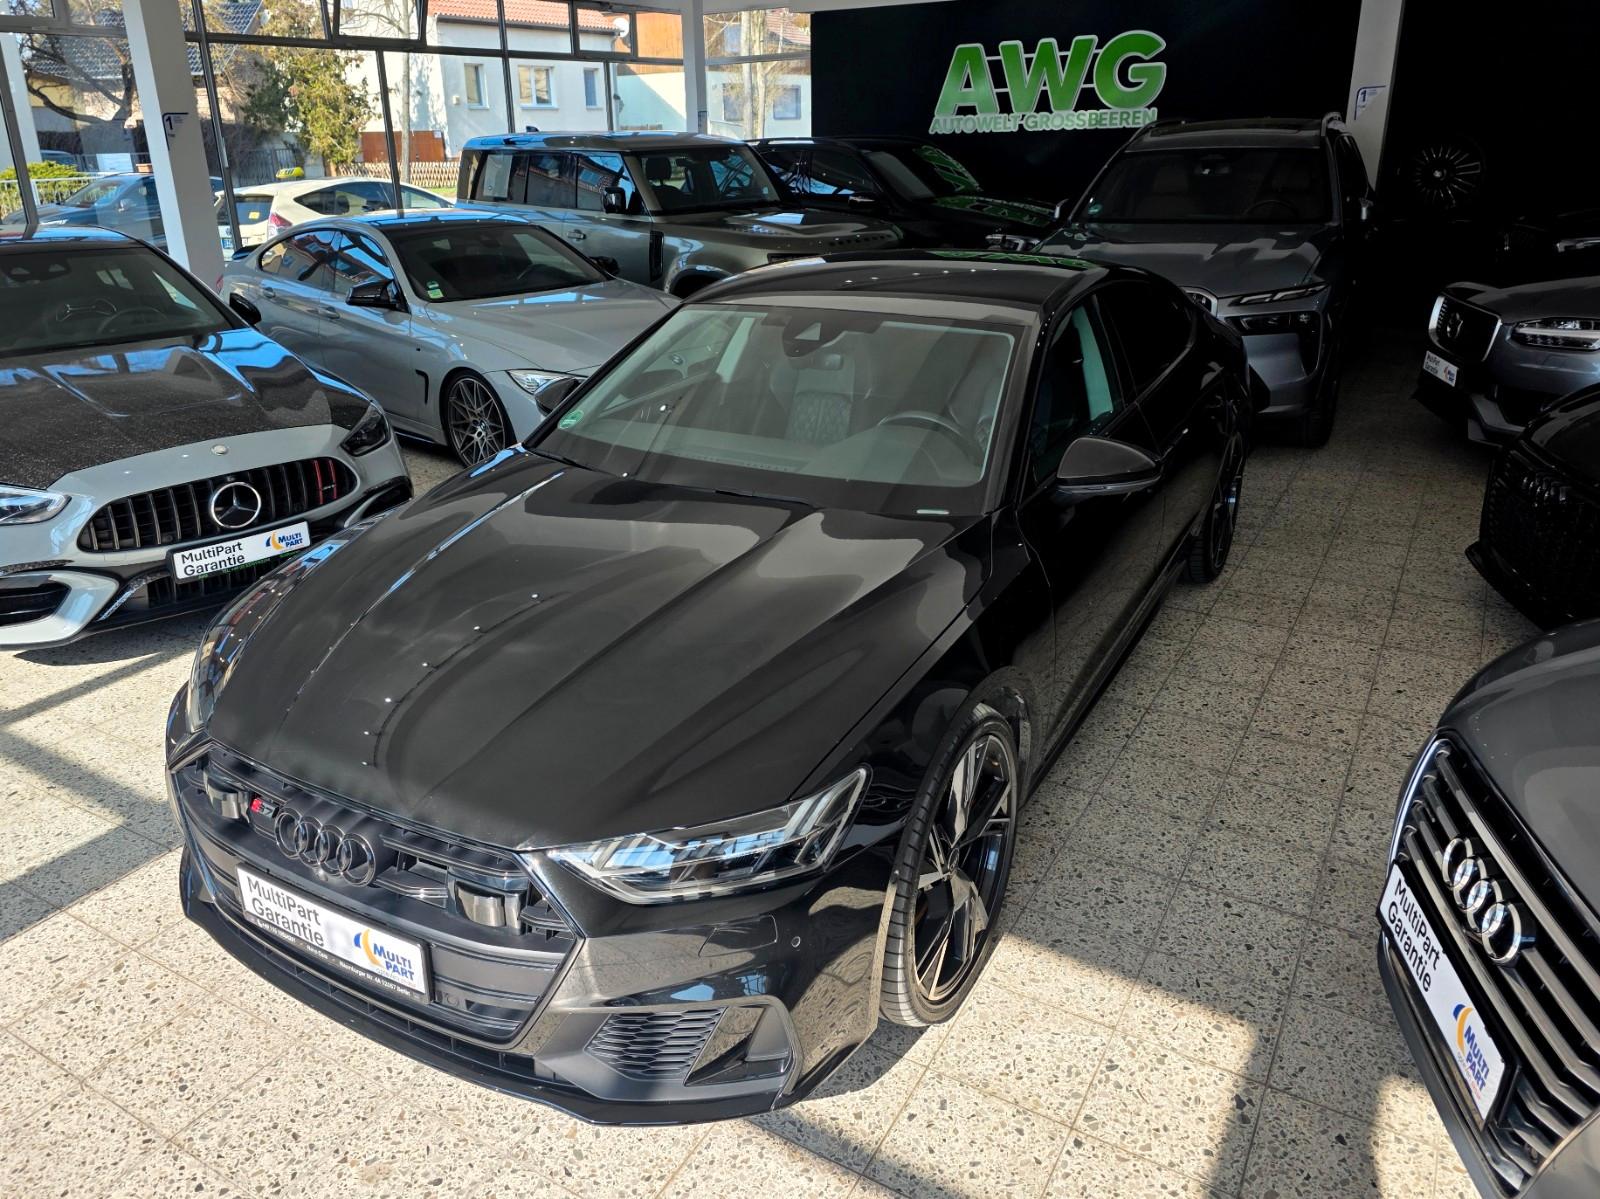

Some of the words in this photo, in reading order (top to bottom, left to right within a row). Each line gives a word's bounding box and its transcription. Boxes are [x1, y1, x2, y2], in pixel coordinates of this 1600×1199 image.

[934, 29, 1167, 115] AWG
[929, 113, 1021, 134] AUTOWELT
[1023, 108, 1158, 131] GROSSBEEREN
[181, 542, 243, 564] MultiPart
[277, 532, 302, 544] MULTI
[285, 538, 303, 548] PART
[183, 554, 245, 577] Garantie
[247, 876, 320, 925] MultiPart
[252, 897, 325, 947] Garantie
[1394, 878, 1440, 971] MultiPart
[373, 943, 412, 969] MULTI
[1388, 900, 1432, 992] Garantie
[385, 960, 415, 981] PART
[1464, 1025, 1490, 1079] MULTI
[1466, 1051, 1486, 1092] PART
